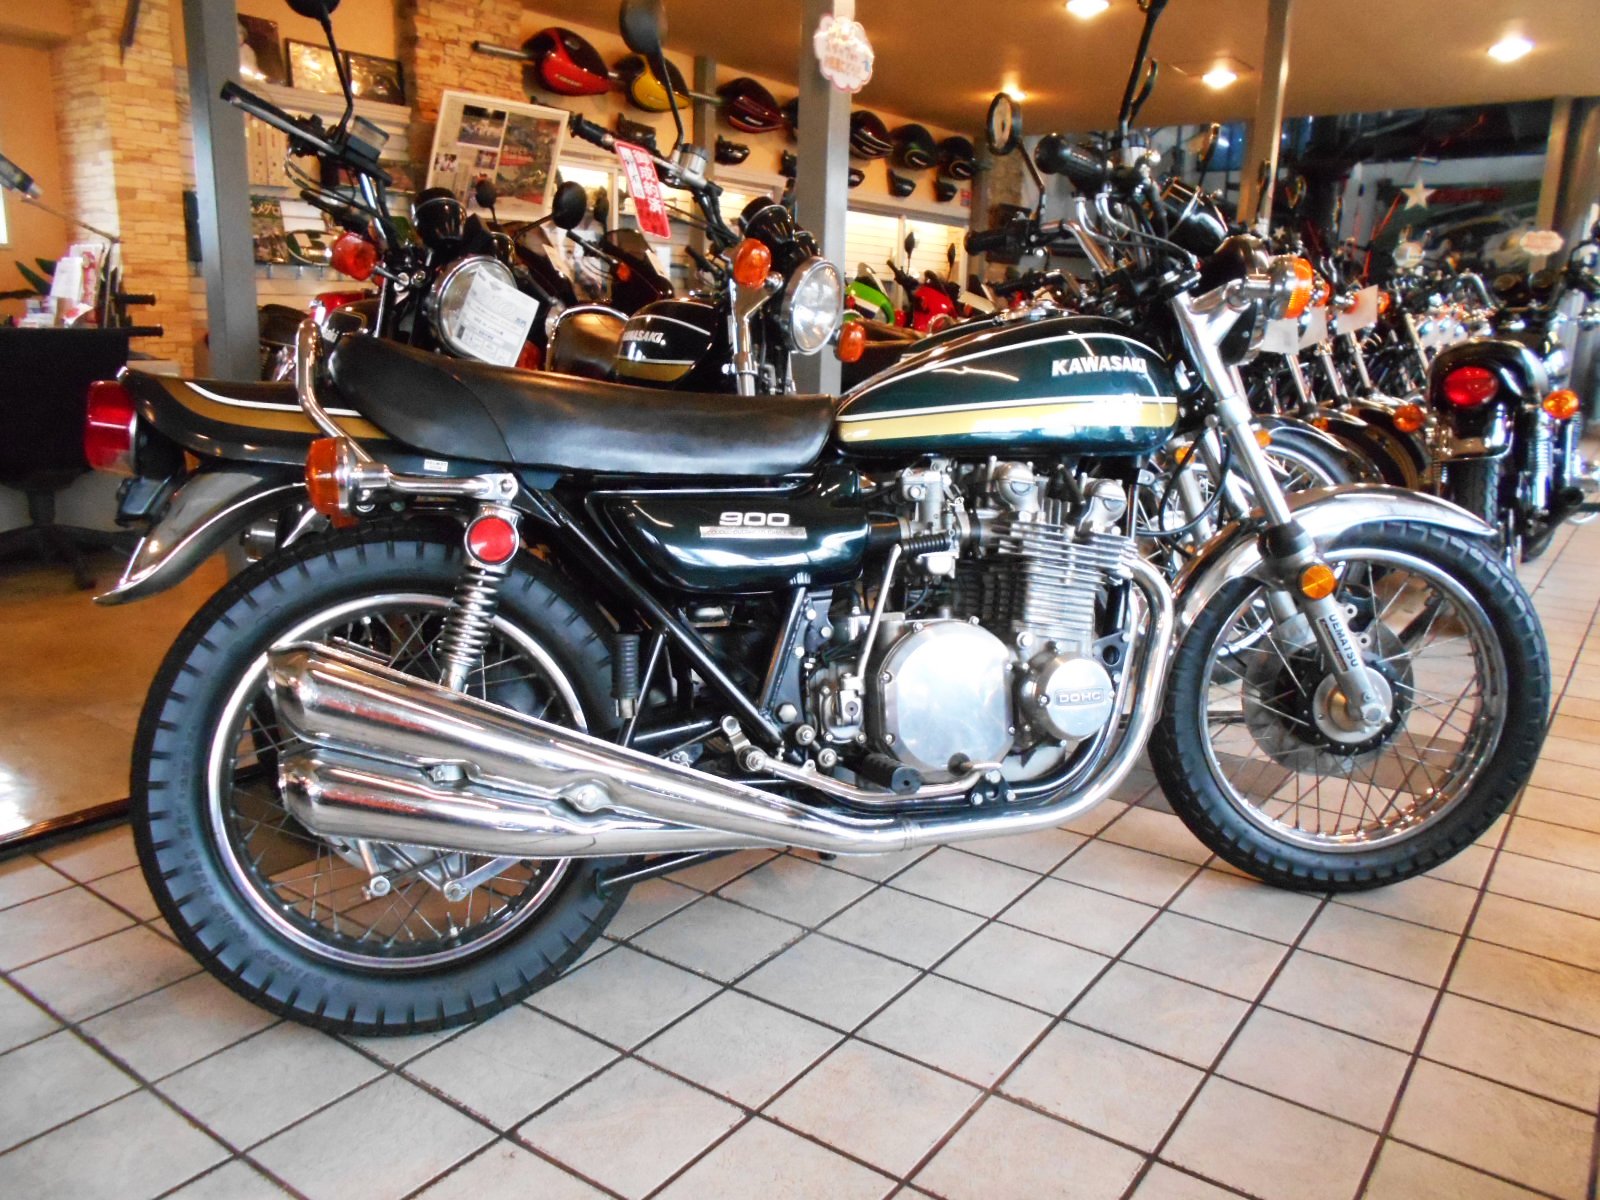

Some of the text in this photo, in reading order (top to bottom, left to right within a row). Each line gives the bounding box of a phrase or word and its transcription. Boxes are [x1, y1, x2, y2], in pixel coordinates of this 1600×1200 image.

[1051, 355, 1148, 377] KAWASAKI
[719, 511, 790, 526] 900
[1328, 613, 1359, 668] UEMATSU
[1059, 691, 1102, 703] DOHC
